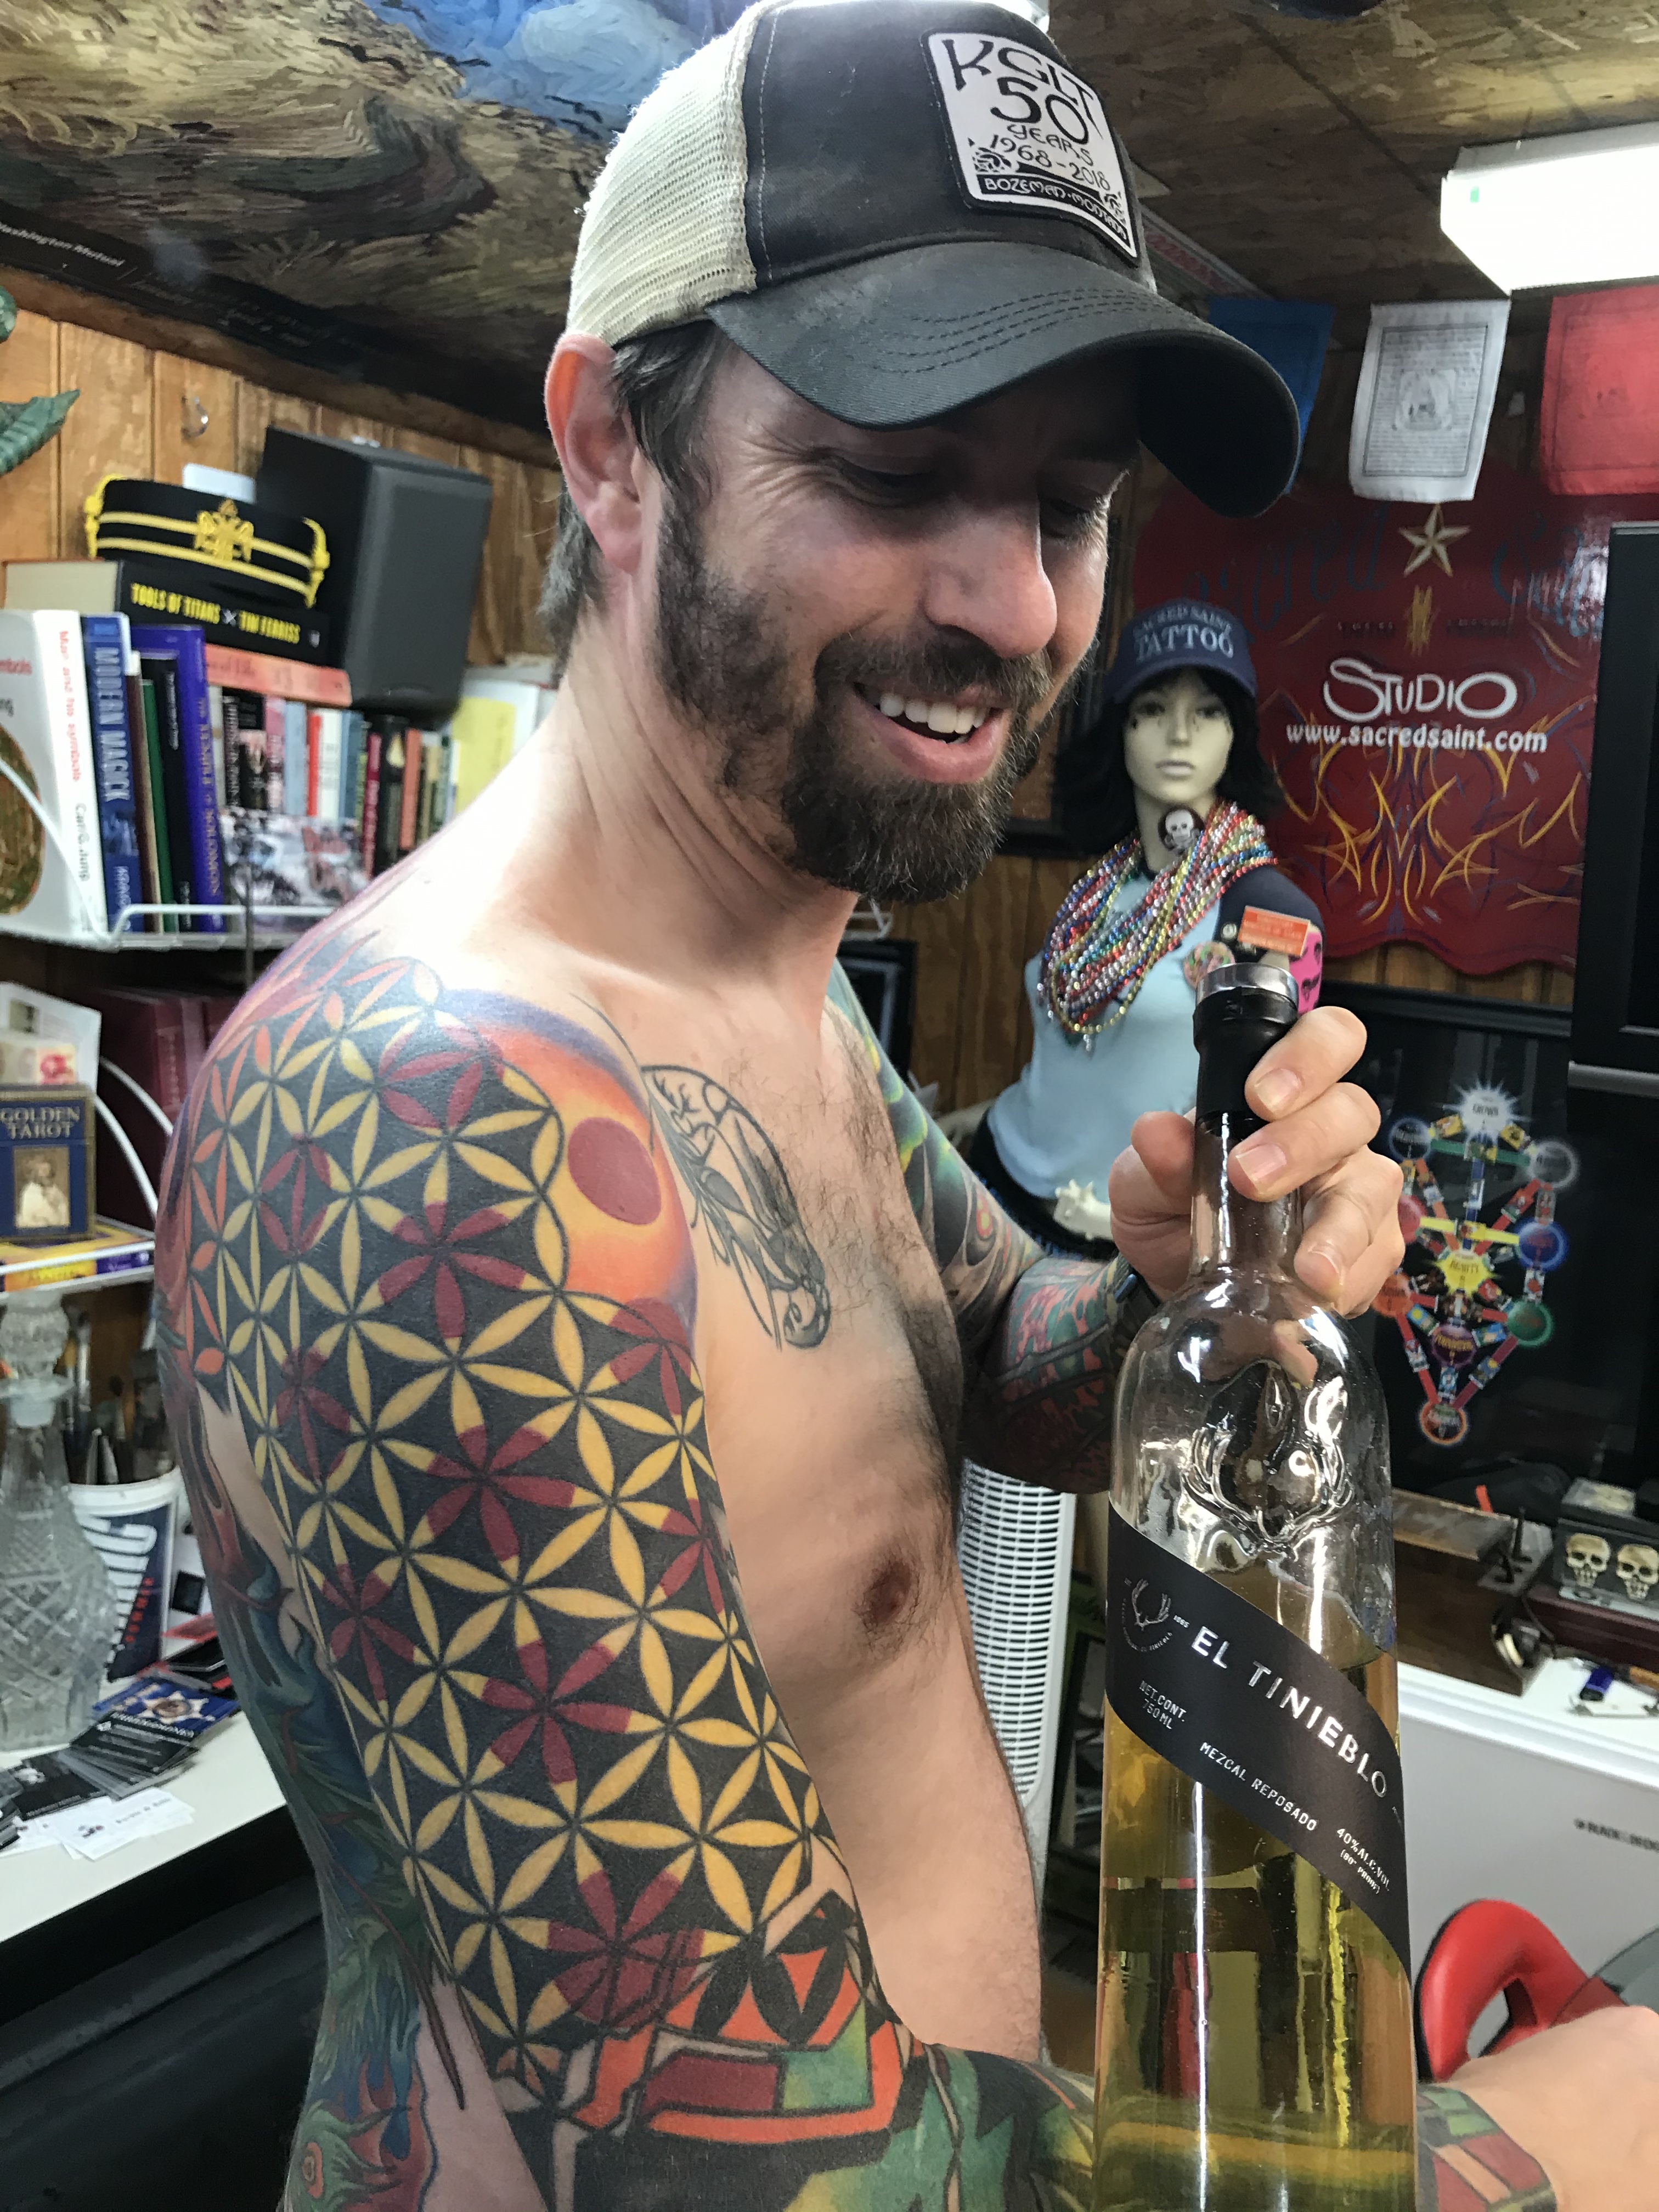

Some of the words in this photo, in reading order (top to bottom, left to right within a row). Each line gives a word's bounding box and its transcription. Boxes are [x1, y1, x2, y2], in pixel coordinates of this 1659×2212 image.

[990, 76, 1088, 143] 50
[1006, 123, 1094, 167] YEARS
[1135, 623, 1234, 660] TATTOO
[94, 647, 125, 725] MODERN
[99, 730, 131, 801] MAGICK
[1285, 723, 1549, 753] www.sacredsaint.com
[0, 1105, 81, 1123] GOLDEN
[1190, 1625, 1231, 1669] EL
[1248, 1660, 1387, 1798] TINIEBLO
[1199, 1742, 1246, 1782] MEZCAL
[1251, 1778, 1319, 1832] REPOSADO
